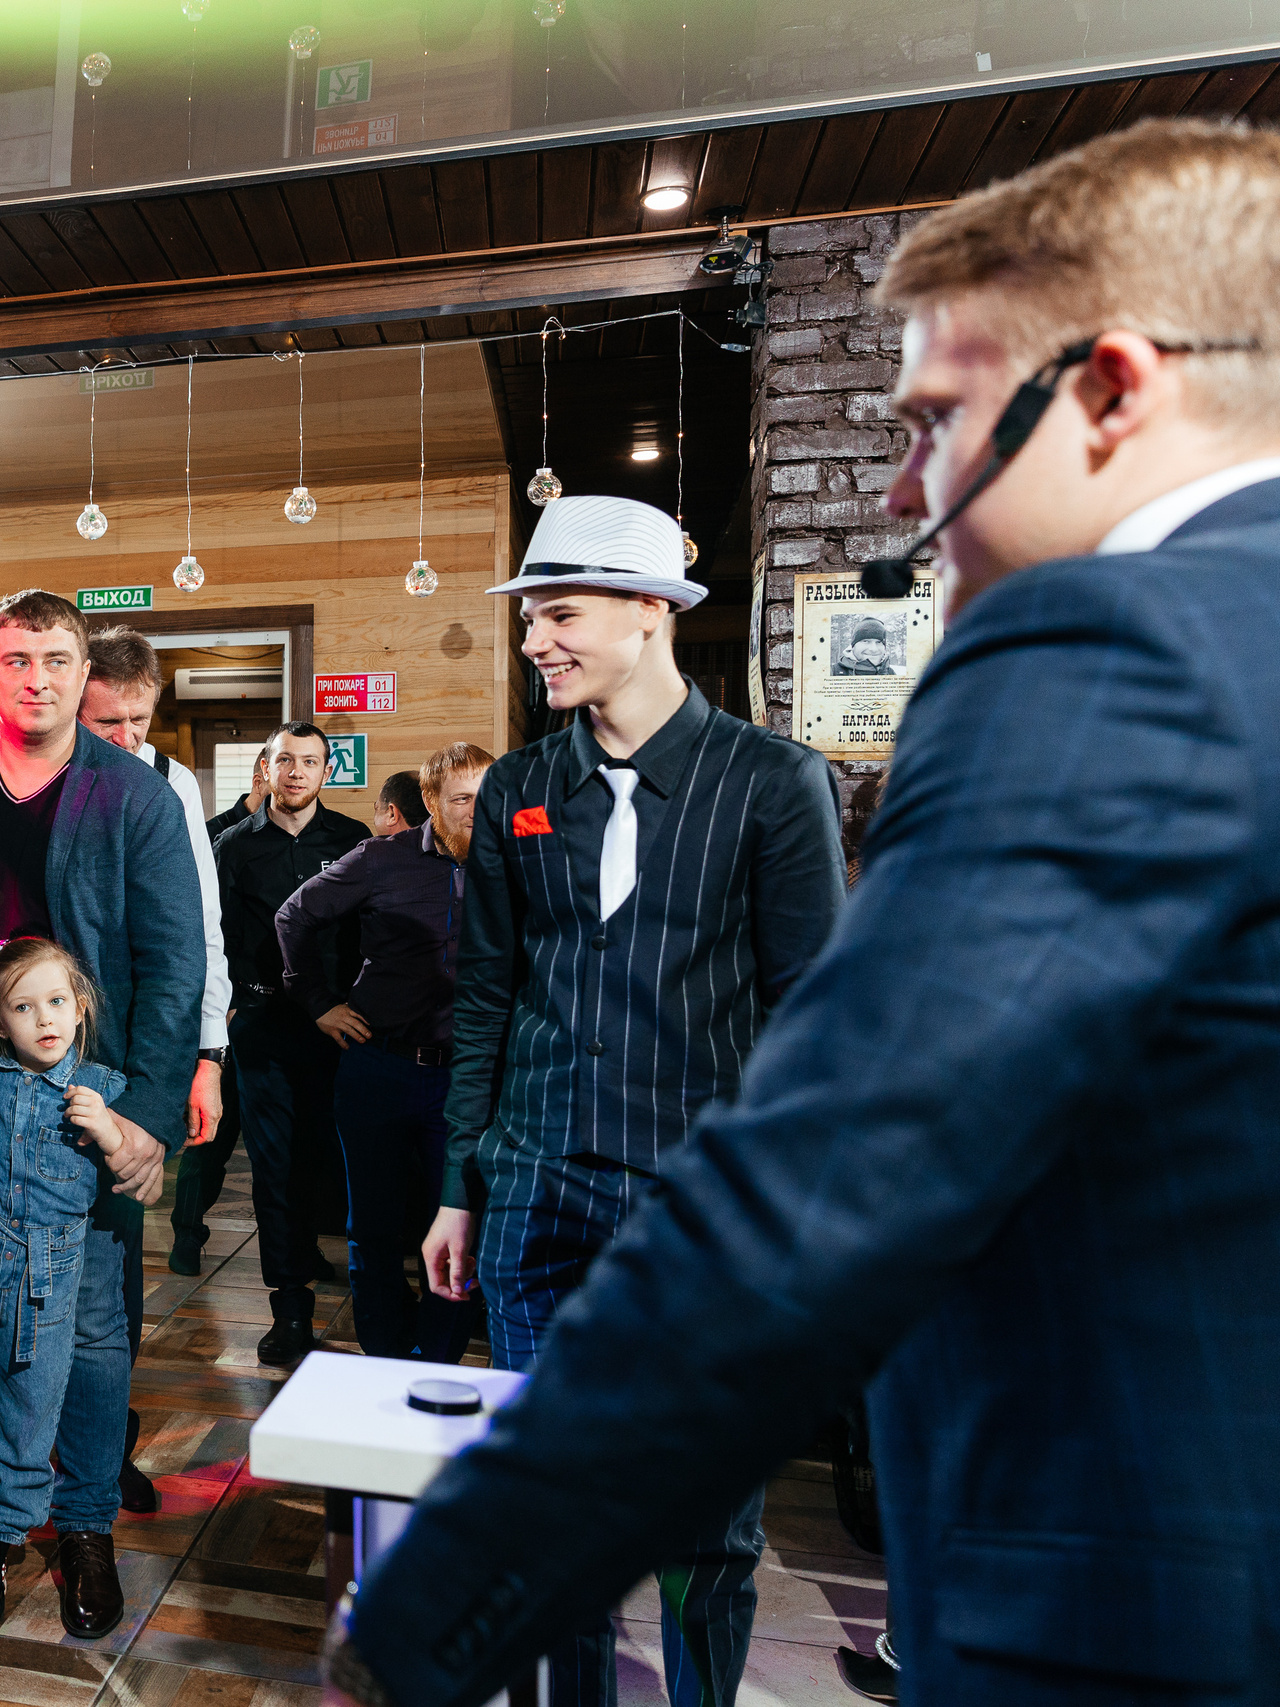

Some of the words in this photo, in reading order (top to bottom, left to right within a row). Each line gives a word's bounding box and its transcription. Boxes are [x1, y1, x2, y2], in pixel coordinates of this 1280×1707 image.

[806, 582, 931, 600] РАЗЫСКСЯ
[83, 590, 145, 606] ВЫХОД
[318, 680, 332, 691] ПРИ
[334, 679, 365, 691] ПОЖАРЕ
[375, 681, 387, 691] 01
[324, 695, 358, 707] ЗВОНИТЬ
[372, 698, 390, 709] 112
[842, 715, 891, 727] НАГРАДА
